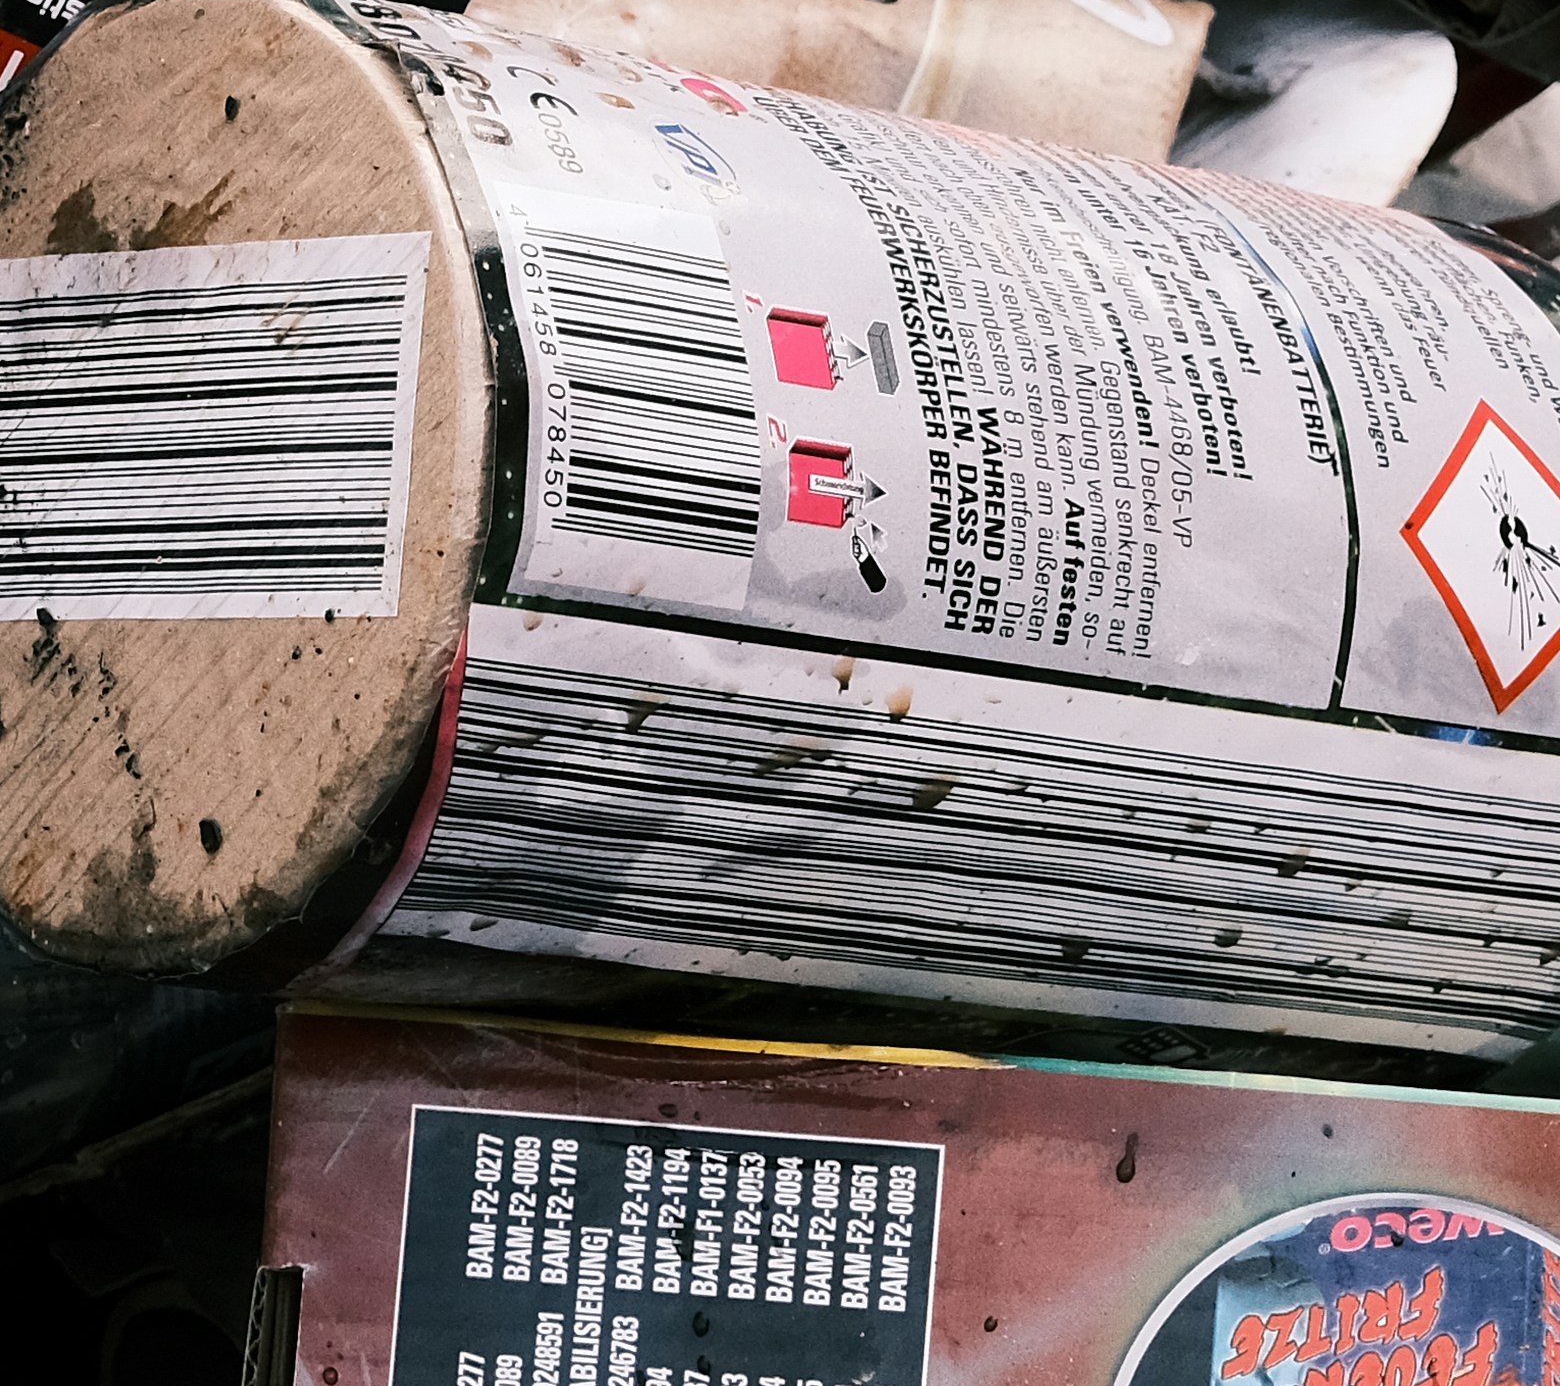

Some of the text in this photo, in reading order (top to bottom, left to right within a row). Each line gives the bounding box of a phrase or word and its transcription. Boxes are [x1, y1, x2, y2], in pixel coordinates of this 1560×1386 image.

[517, 241, 557, 359] 061458
[1194, 287, 1261, 380] erlaubt!
[1195, 215, 1334, 467] (FONTÄNENBATTERIE)
[531, 381, 577, 509] 078450
[843, 174, 949, 600] FEUERWERKSKÖRPER BEFINDET.
[890, 203, 977, 630] SICHERZUSTELLEN, DASS SICH
[1097, 299, 1159, 450] verwenden!
[1140, 331, 1204, 550] BAM-4468/05-VP
[1175, 351, 1226, 478] verboten!
[1201, 355, 1253, 483] verboten!
[971, 406, 1009, 636] WÄHREND DER
[1133, 454, 1167, 535] Deckel
[1053, 496, 1083, 645] Auf festen
[1131, 541, 1160, 661] entfernen!
[465, 1132, 503, 1279] BAM-F2-0277
[503, 1135, 541, 1282] BAM-F2-0089
[541, 1137, 579, 1285] BAM-F2-1718
[616, 1143, 654, 1291] BAM-F2-1423
[653, 1146, 692, 1293] BAM-F2-1194
[1220, 1266, 1443, 1377] FRITZE
